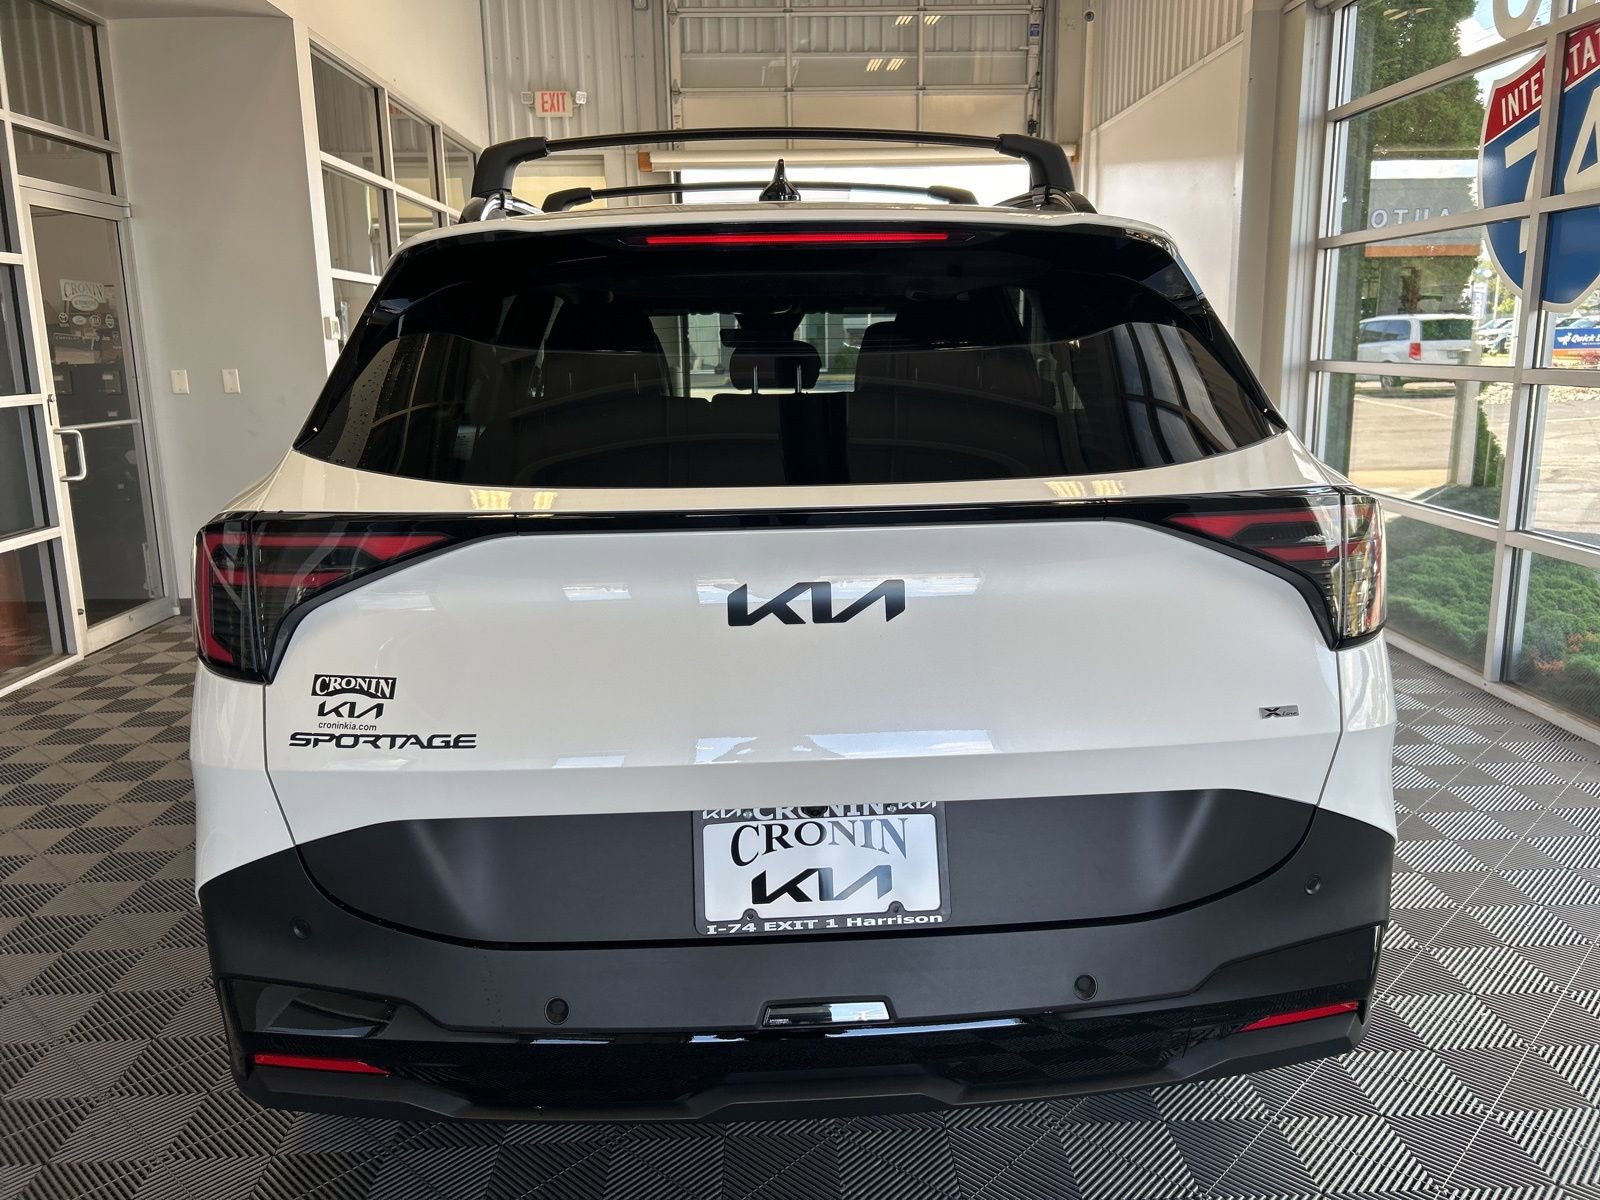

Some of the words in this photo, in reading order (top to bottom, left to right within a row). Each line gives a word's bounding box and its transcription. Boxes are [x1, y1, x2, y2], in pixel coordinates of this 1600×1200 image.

[1501, 27, 1600, 126] INTETA
[541, 92, 567, 112] EXIT
[64, 282, 104, 301] CRONIN
[1571, 333, 1595, 343] Quick
[728, 579, 906, 626] KIA
[315, 676, 394, 698] CRONIN
[317, 700, 384, 719] KIA
[318, 722, 377, 732] croninkia.com
[289, 732, 477, 750] SPORTAGE
[730, 817, 909, 867] CRONIN
[751, 864, 893, 905] KIA
[706, 922, 757, 935] I-74
[764, 919, 818, 932] EXIT
[826, 918, 838, 928] 1
[846, 914, 943, 927] Harrison
